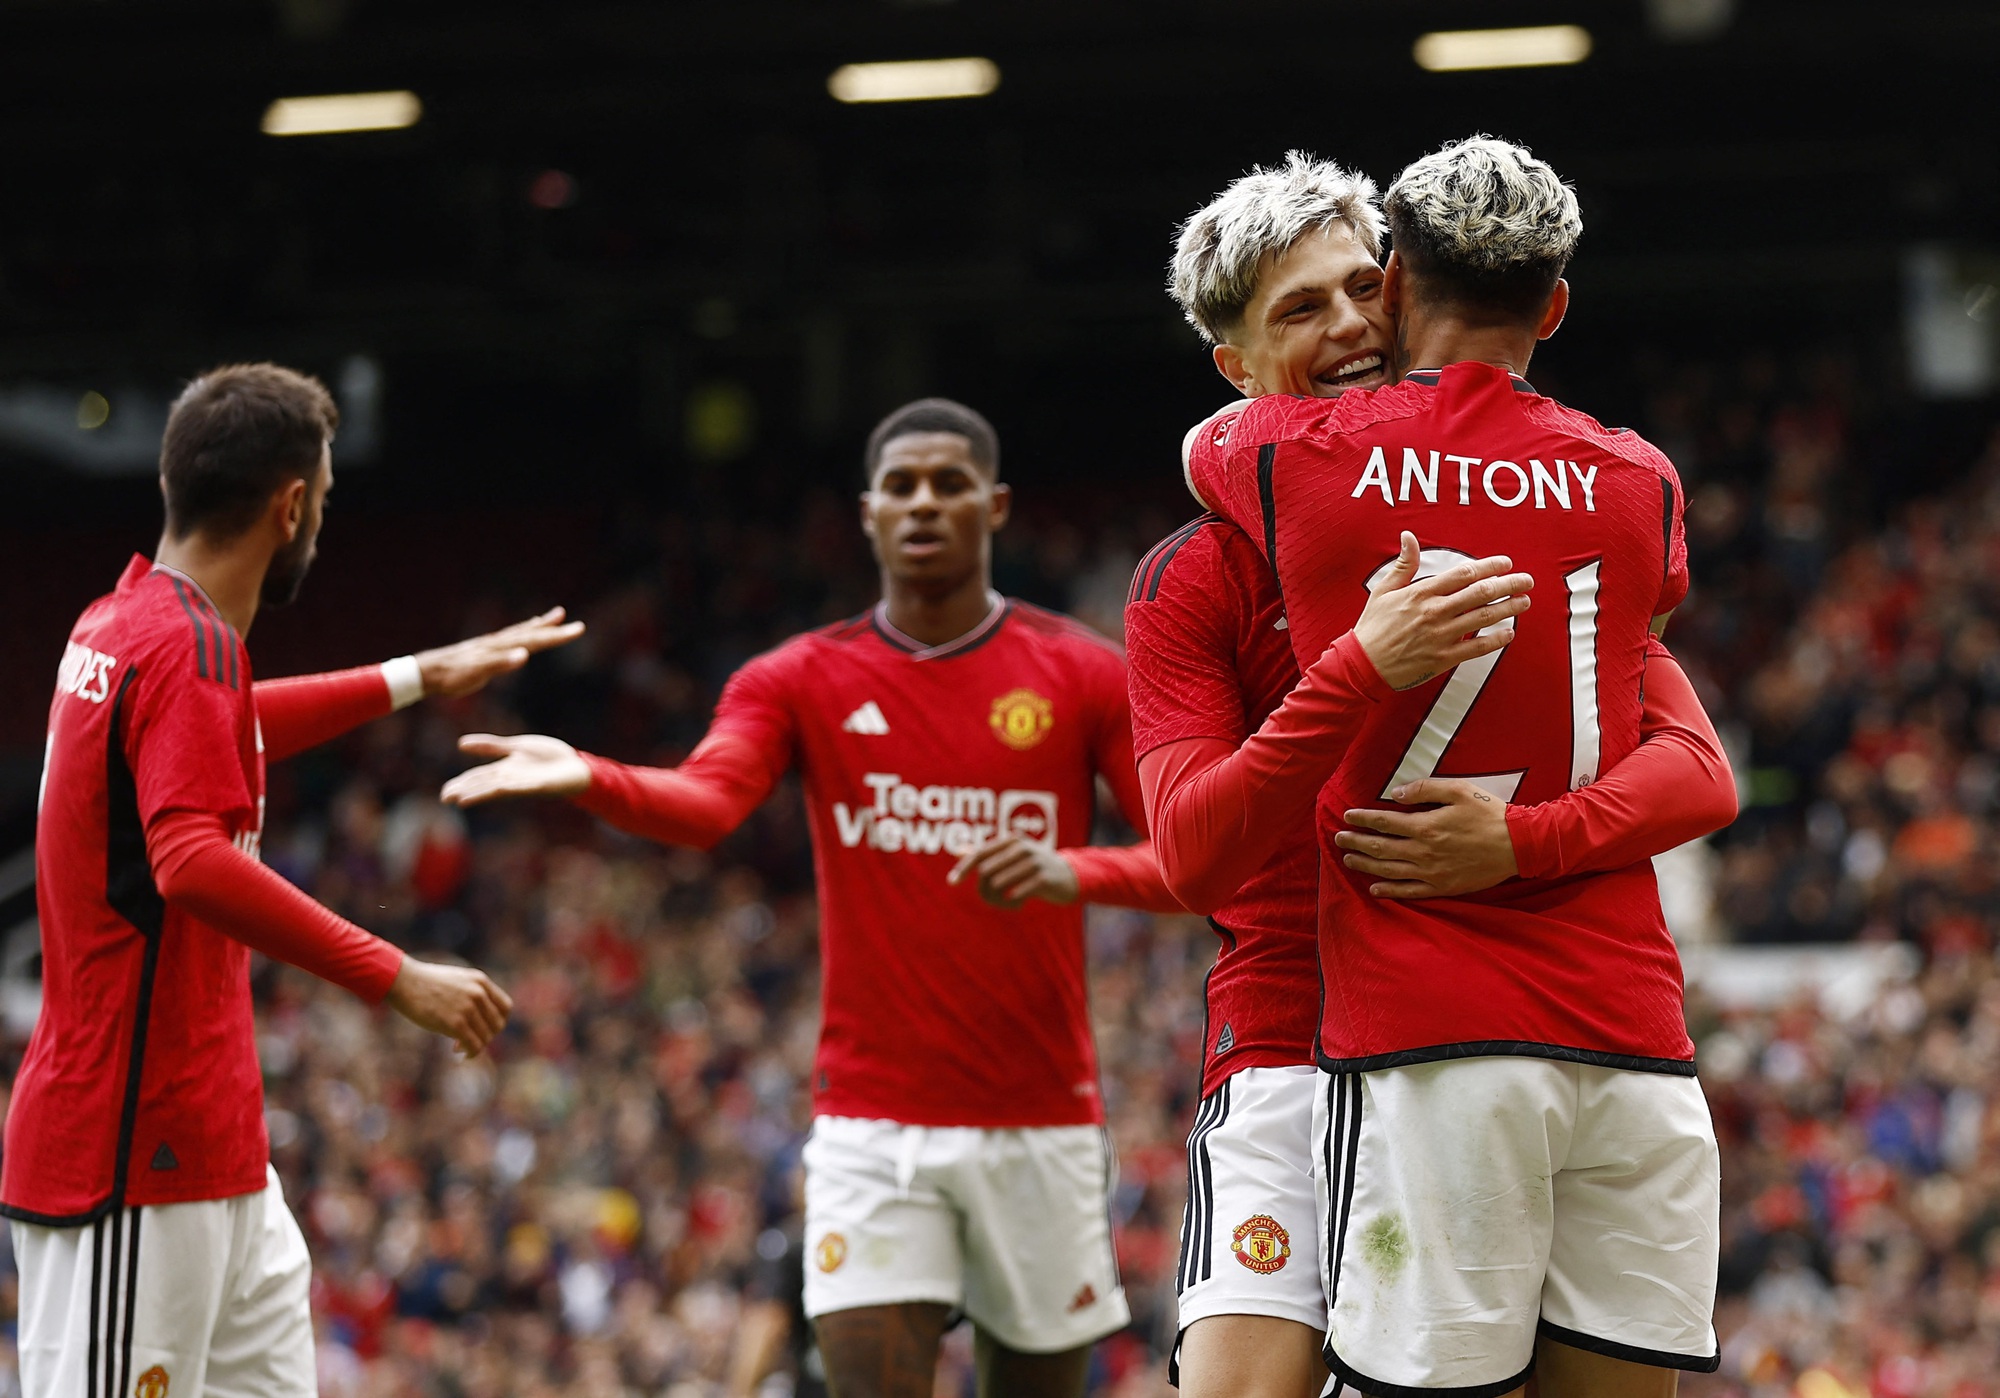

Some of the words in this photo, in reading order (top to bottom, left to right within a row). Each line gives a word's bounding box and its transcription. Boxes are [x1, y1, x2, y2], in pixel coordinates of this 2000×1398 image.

[1351, 446, 1599, 512] ANTONY
[1362, 546, 1603, 803] 21
[862, 772, 996, 823] Team
[832, 800, 998, 856] Viewer
[1237, 1218, 1286, 1241] MANCHESTER
[1245, 1258, 1280, 1270] UNITED
